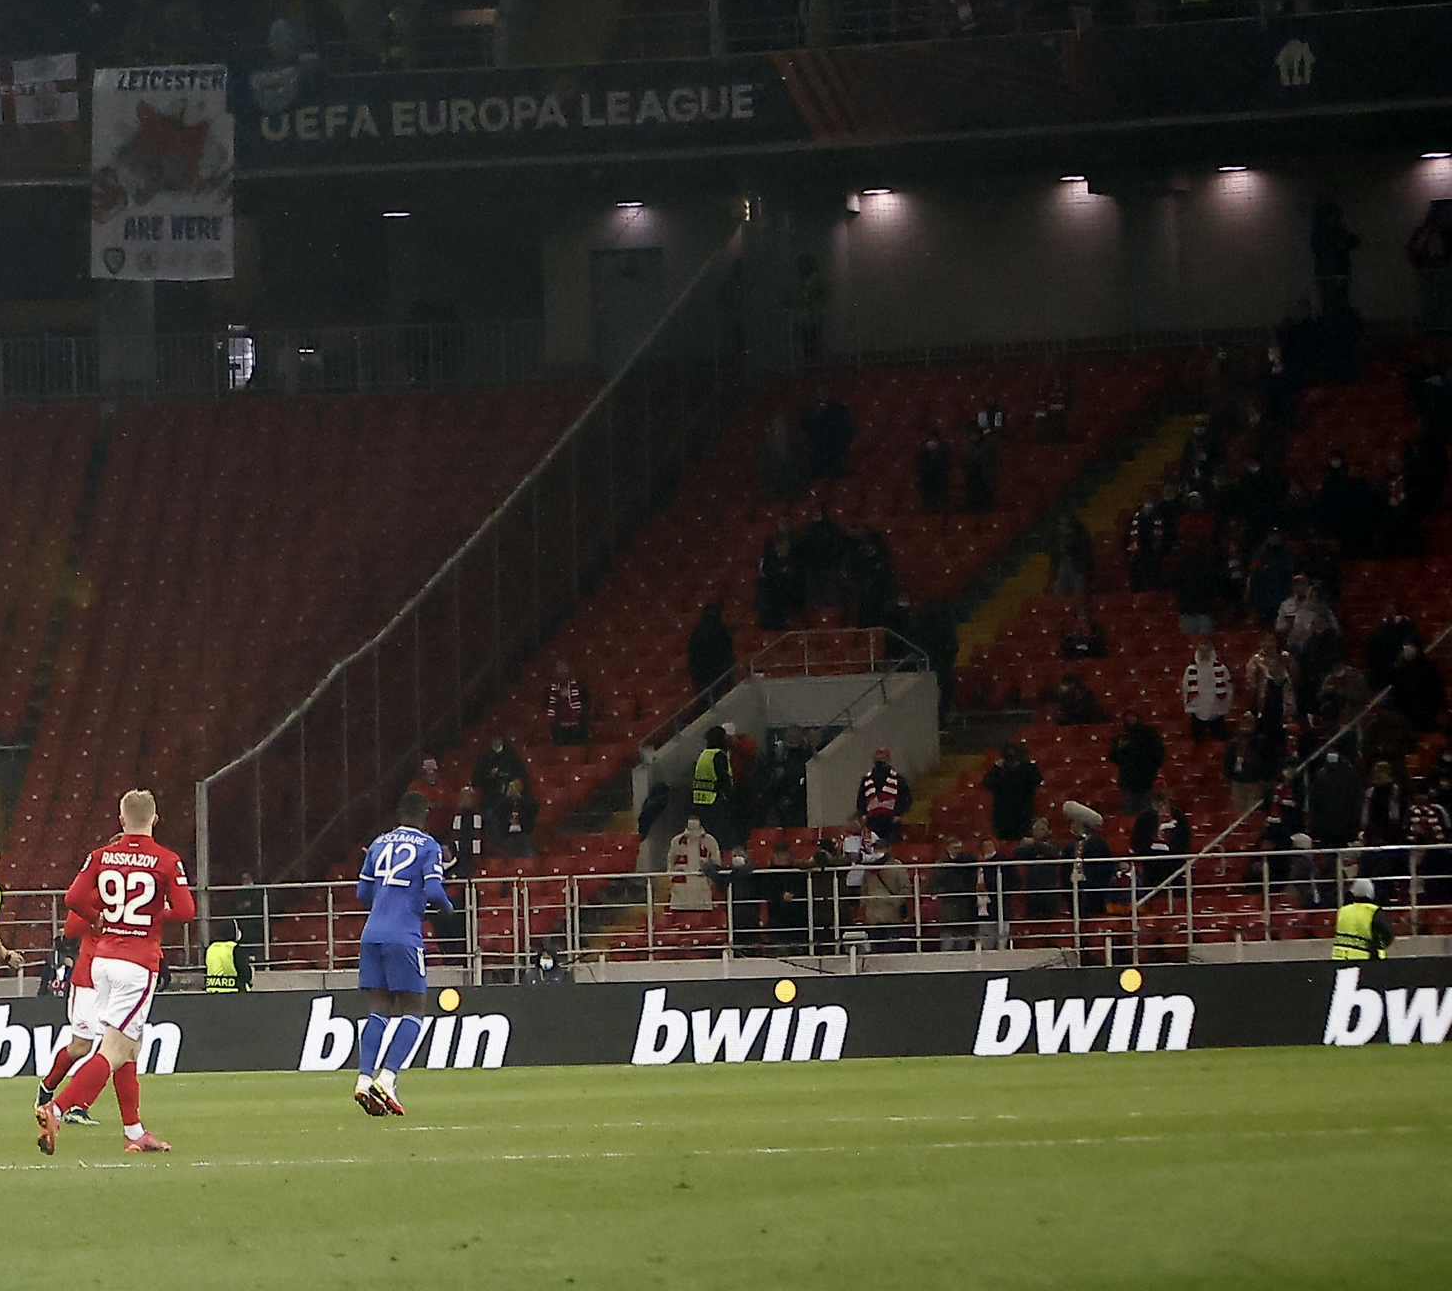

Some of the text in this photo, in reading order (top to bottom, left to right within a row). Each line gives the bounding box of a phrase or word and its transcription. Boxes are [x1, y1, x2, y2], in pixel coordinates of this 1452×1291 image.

[391, 94, 569, 137] EUROPA
[581, 83, 755, 128] LEAGUE
[101, 851, 159, 869] RASSKAZOV
[374, 842, 417, 887] 42
[97, 869, 156, 926] 92
[632, 979, 848, 1066] bwin
[973, 969, 1195, 1055] bwin
